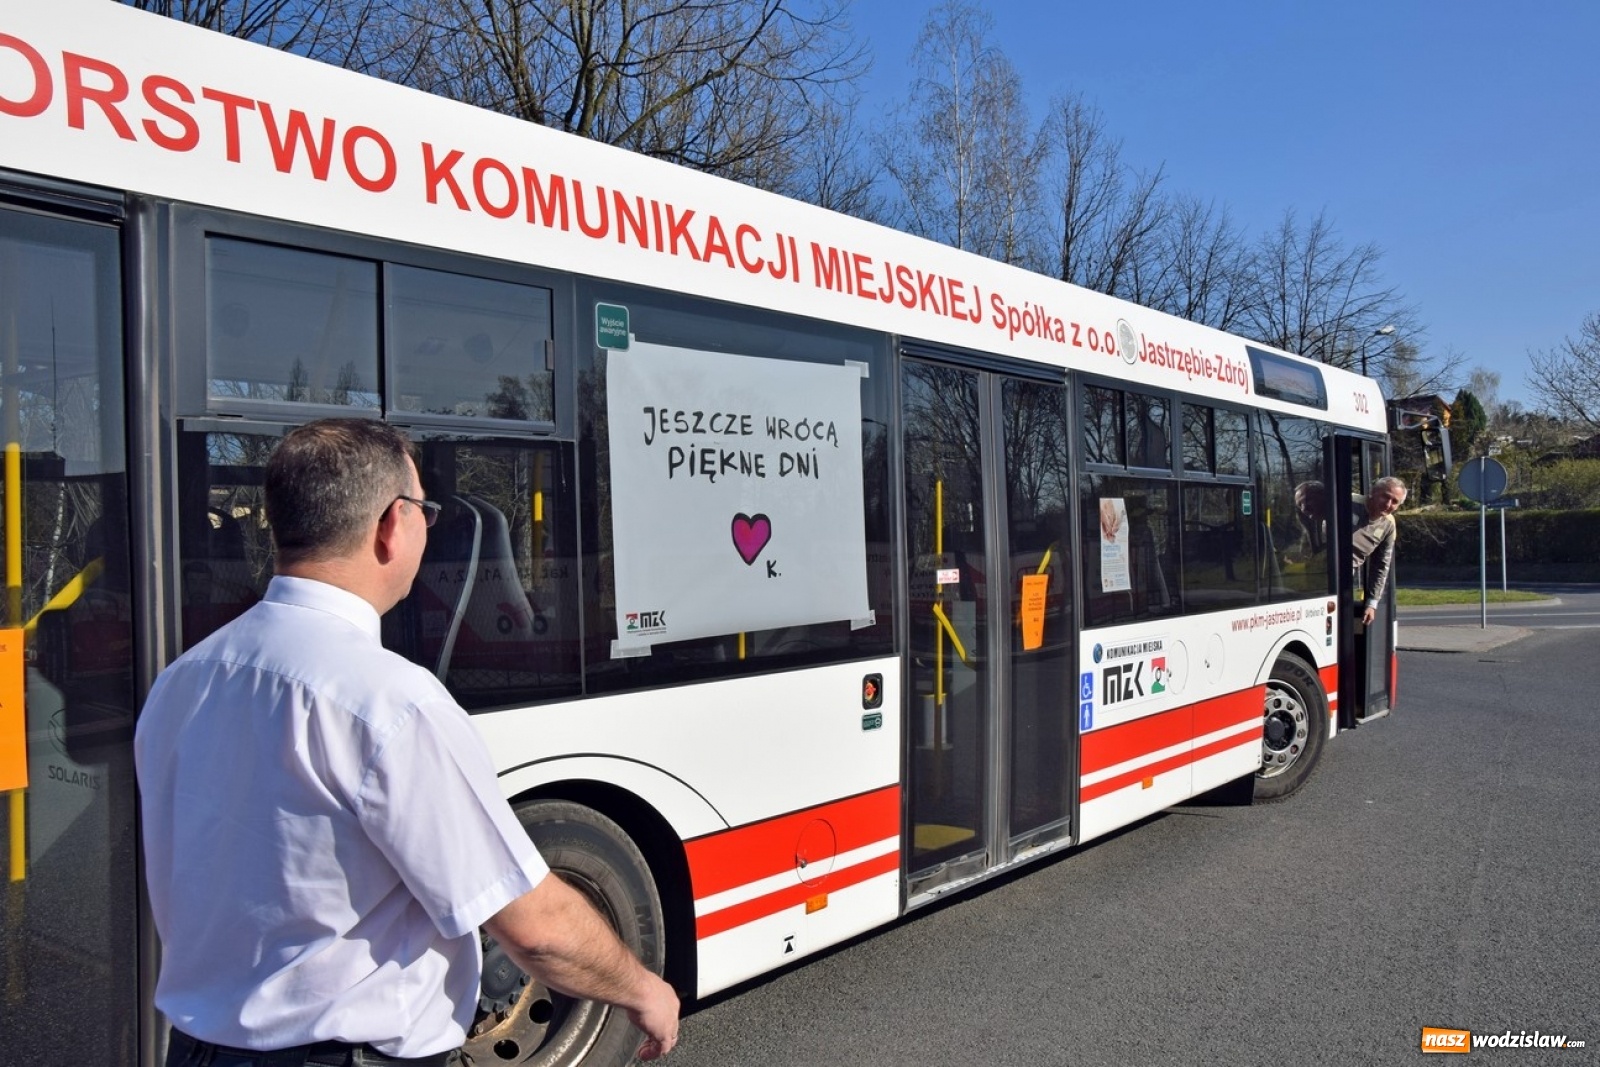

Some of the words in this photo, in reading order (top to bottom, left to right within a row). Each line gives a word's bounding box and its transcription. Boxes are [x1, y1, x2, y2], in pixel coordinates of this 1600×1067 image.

[421, 142, 800, 283] KOMUNIKACJI
[811, 242, 983, 324] MIEJSKIEJ
[991, 292, 1066, 342] Spółka
[1071, 323, 1083, 347] z
[1087, 327, 1121, 358] o.o.
[1138, 332, 1250, 395] Jastrzębie-Zdrój
[600, 316, 625, 327] Wyjście
[643, 406, 754, 446] JESZCZE
[765, 416, 839, 449] WRÓCĄ
[778, 447, 820, 480] DNI
[766, 559, 782, 579] K.
[639, 610, 667, 629] MZK
[1103, 661, 1145, 706] MZK
[48, 764, 101, 790] SOLARIS
